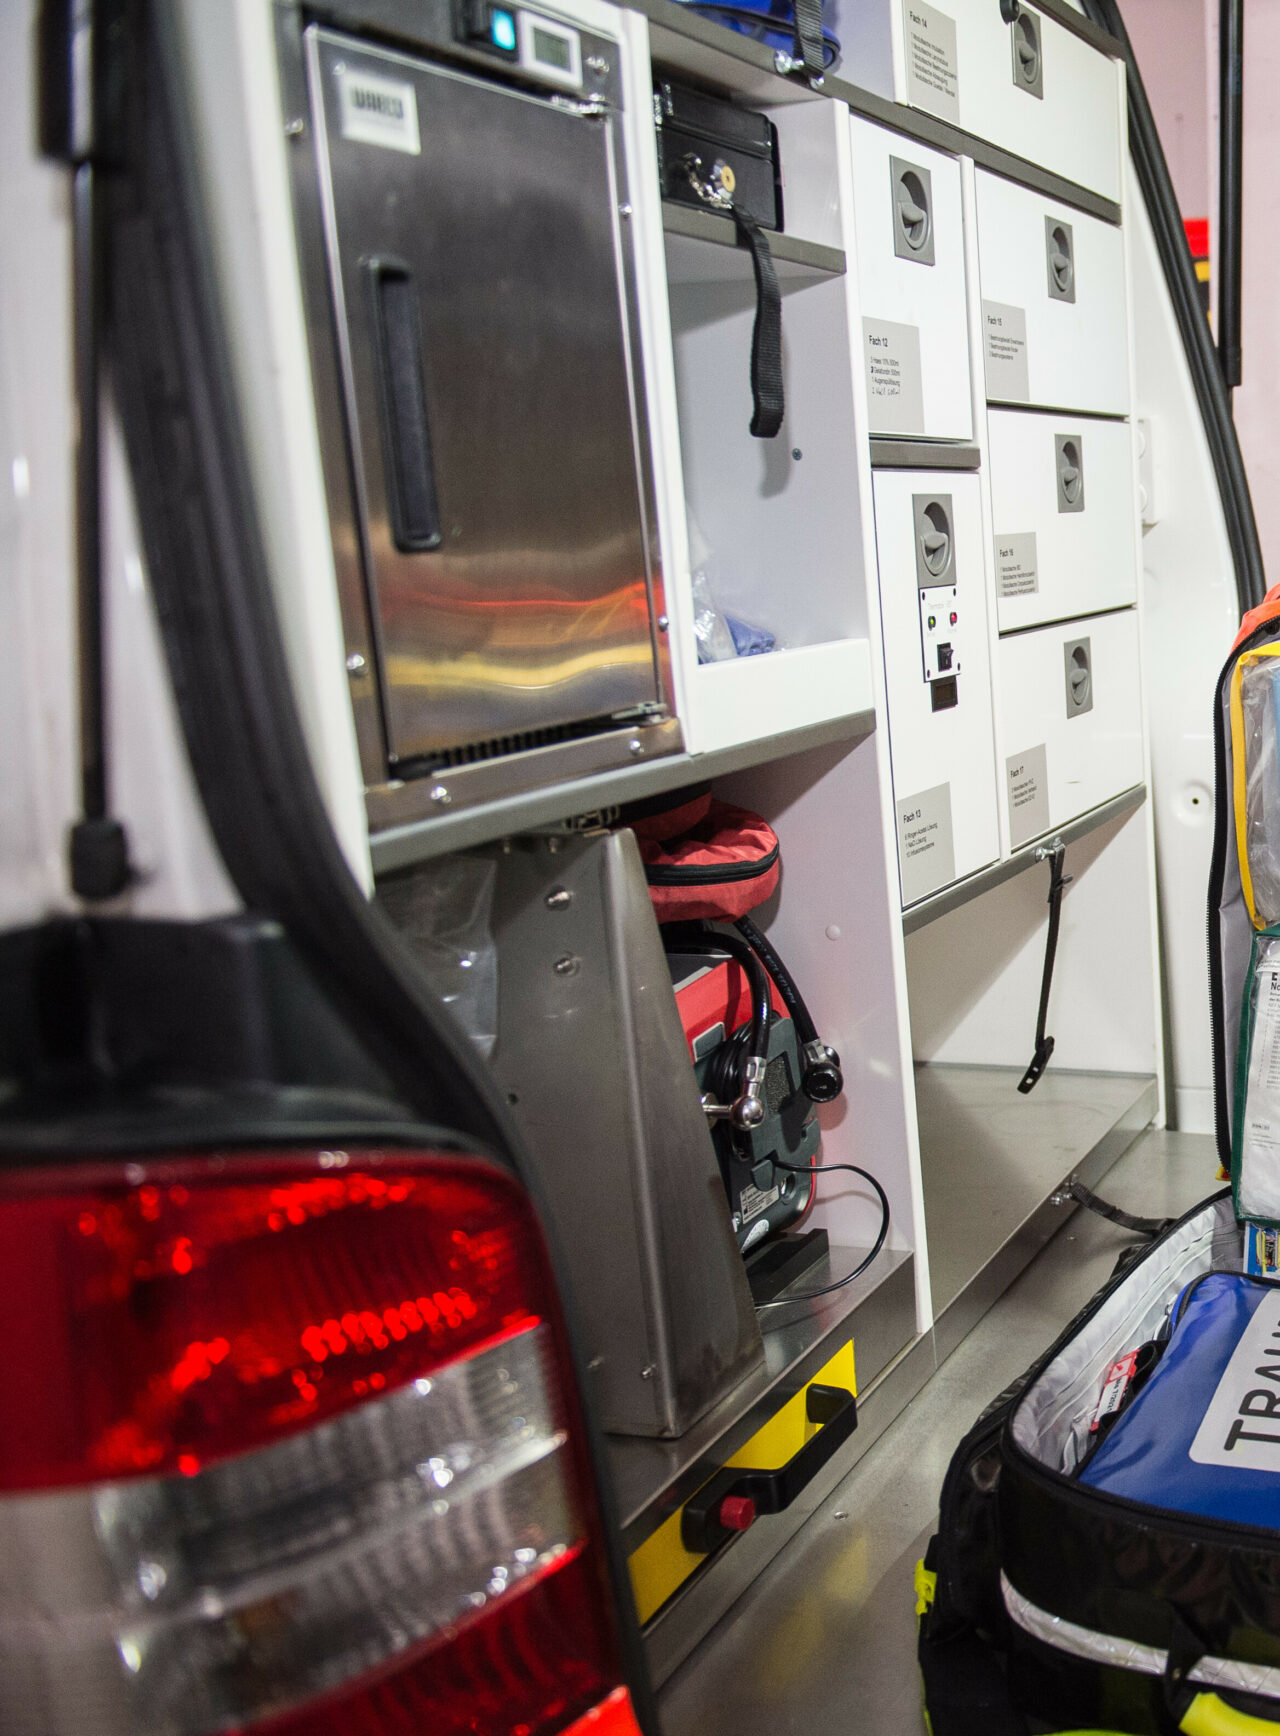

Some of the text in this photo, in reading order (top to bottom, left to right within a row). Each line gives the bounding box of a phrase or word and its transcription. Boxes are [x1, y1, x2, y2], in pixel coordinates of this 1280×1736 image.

[868, 334, 888, 348] Fach 12
[903, 809, 921, 824] Fach 13
